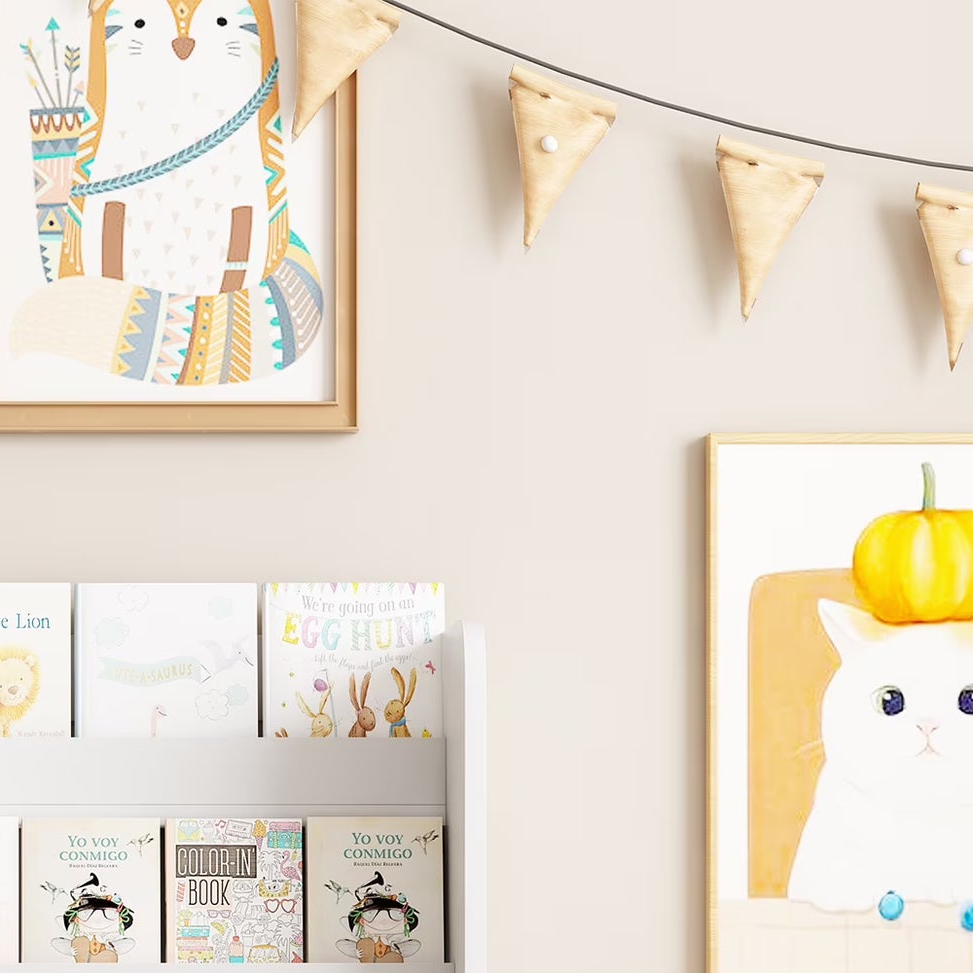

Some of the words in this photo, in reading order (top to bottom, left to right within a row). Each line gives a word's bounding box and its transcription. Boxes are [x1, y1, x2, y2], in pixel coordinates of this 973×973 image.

[302, 595, 335, 611] We're
[339, 600, 374, 617] going
[379, 599, 395, 612] on
[399, 598, 415, 609] an
[16, 613, 50, 629] Lion
[282, 611, 342, 651] EGG
[350, 610, 436, 651] HUNT
[92, 837, 119, 847] VOY
[376, 835, 403, 845] VOY
[59, 851, 128, 861] CONMIGO
[343, 848, 413, 859] CONMIGO
[188, 879, 230, 905] BOOK
